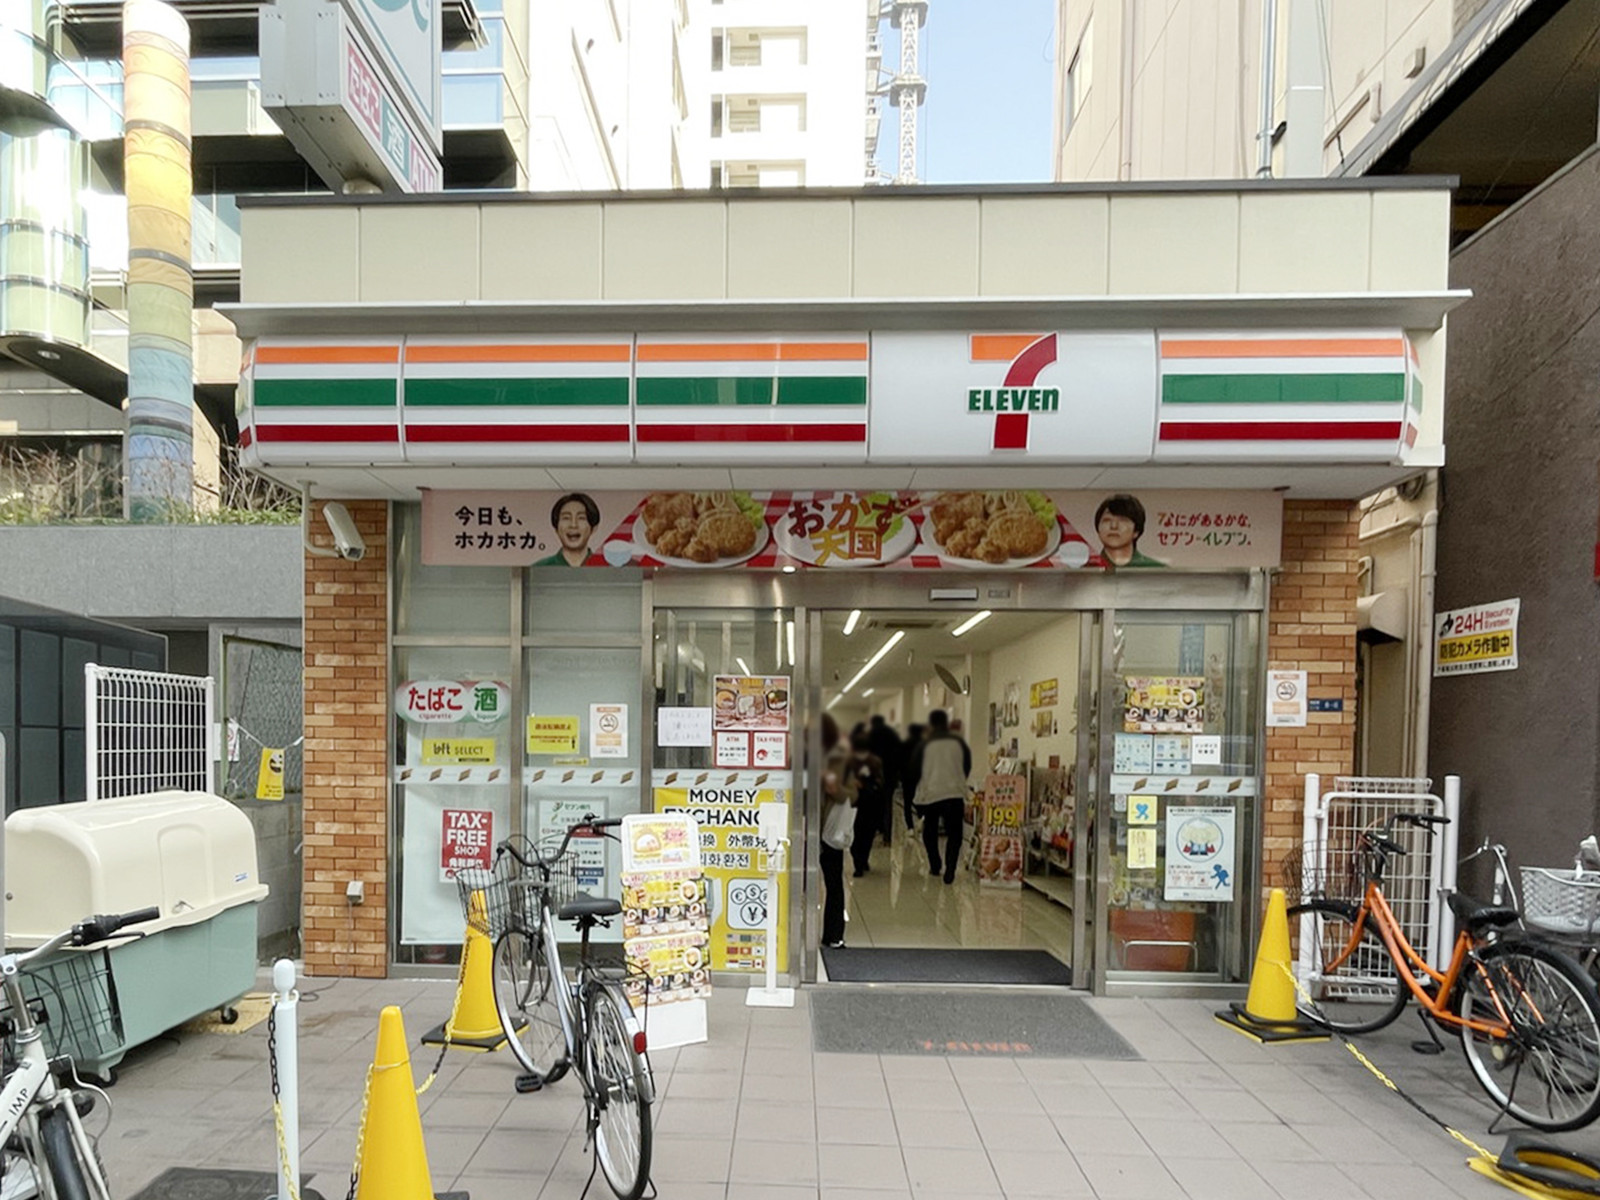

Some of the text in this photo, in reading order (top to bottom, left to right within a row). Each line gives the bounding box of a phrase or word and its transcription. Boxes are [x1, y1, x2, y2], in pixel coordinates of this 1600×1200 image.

[387, 109, 405, 168] 酒
[455, 505, 523, 526] 今日も、
[455, 531, 546, 551] ホカホカ。
[809, 526, 883, 566] 天国
[1455, 612, 1483, 634] 24H
[1485, 607, 1513, 619] Security
[1440, 634, 1510, 659] 防犯カメラ作動中
[408, 687, 463, 711] たばこ
[474, 687, 498, 711] 酒
[689, 789, 757, 803] MONEY
[448, 812, 488, 829] TAX-
[664, 808, 760, 826] CHAN
[447, 829, 487, 847] FREE
[454, 846, 480, 856] SHOP
